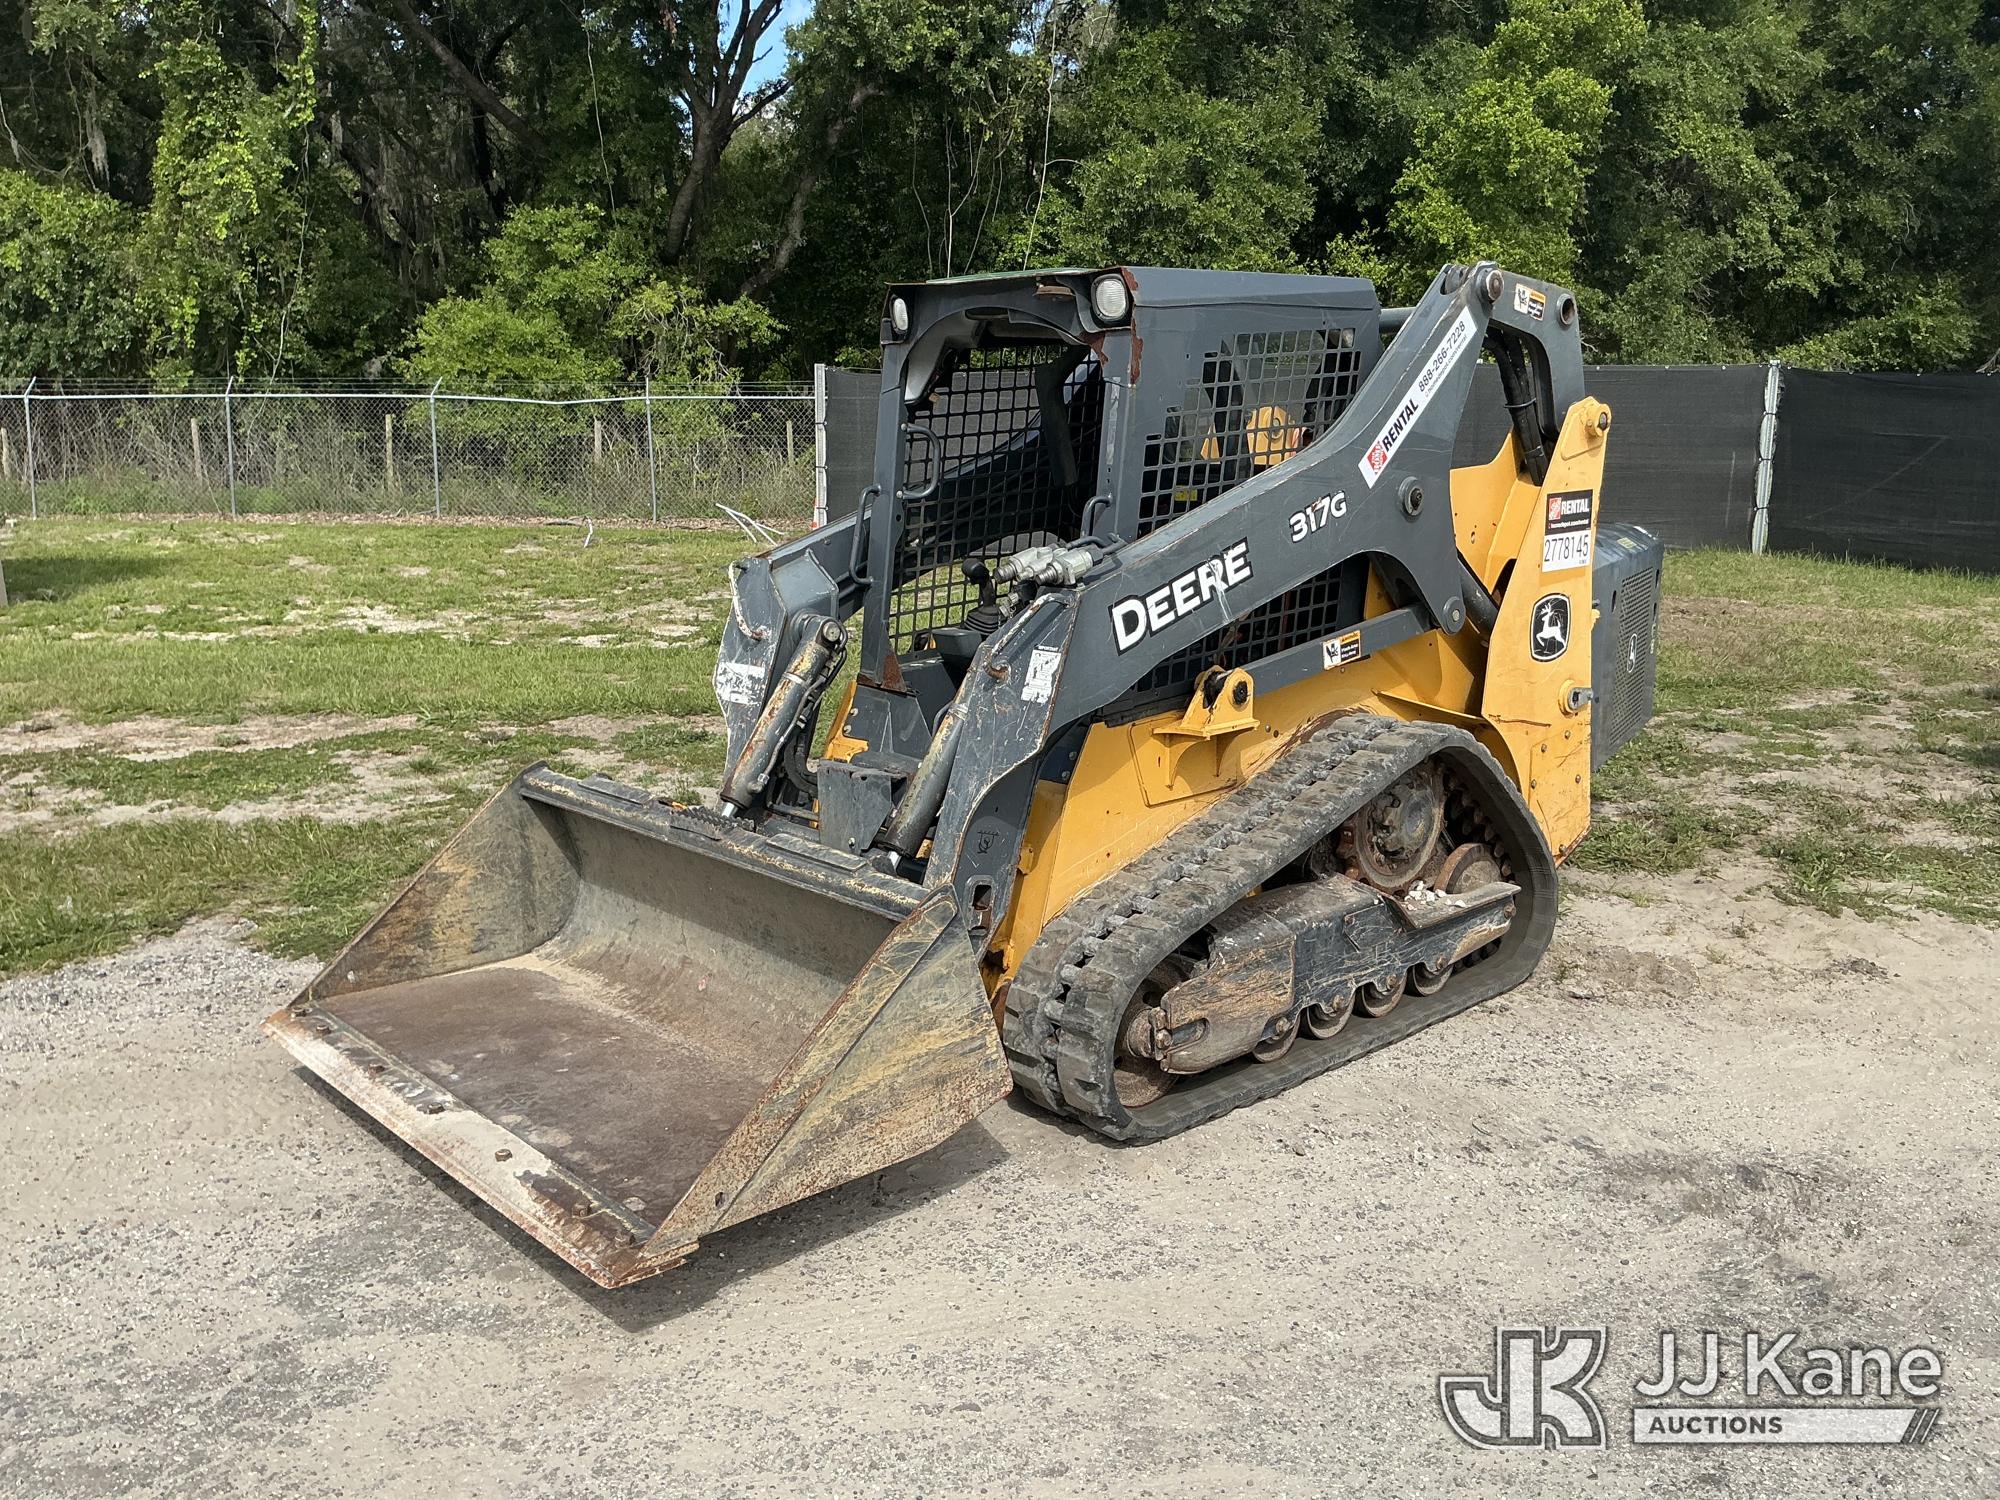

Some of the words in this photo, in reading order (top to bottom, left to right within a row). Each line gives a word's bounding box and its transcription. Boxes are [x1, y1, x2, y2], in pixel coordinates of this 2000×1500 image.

[1418, 320, 1466, 392] 888-266-7228
[1382, 398, 1419, 452] RENTAL
[1289, 490, 1348, 543] 317G
[1561, 498, 1590, 515] RENTAL
[1543, 534, 1589, 562] 2778145
[1110, 540, 1252, 652] DEERE
